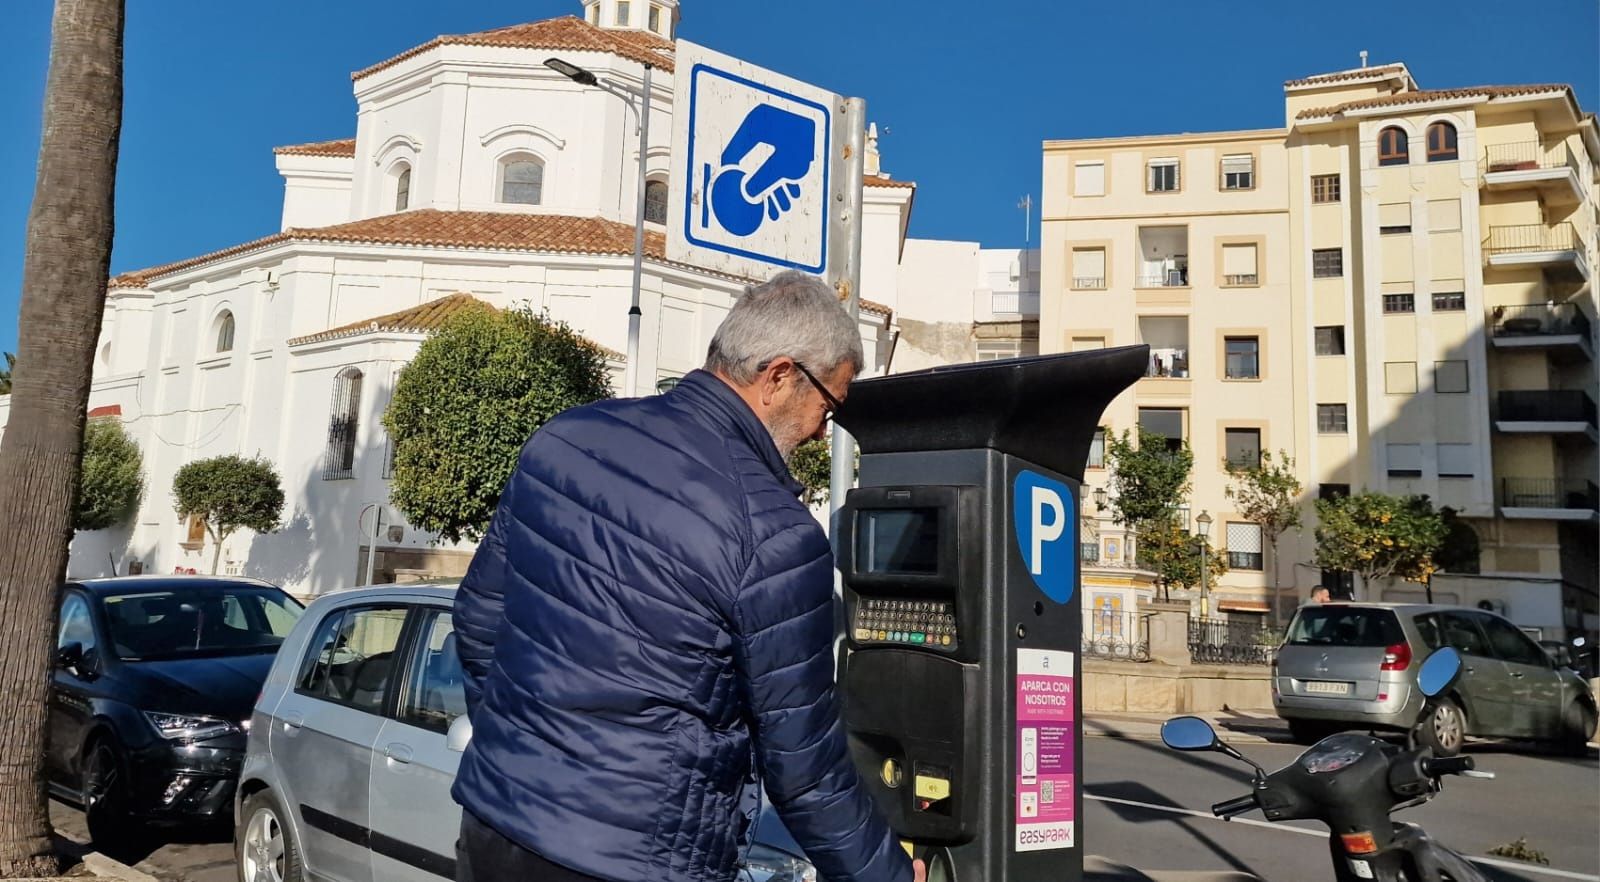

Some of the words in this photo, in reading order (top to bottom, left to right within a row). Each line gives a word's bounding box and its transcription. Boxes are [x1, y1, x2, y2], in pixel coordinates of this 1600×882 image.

[1032, 486, 1065, 575] P
[1021, 681, 1052, 691] APARCA
[1053, 682, 1070, 693] CON
[1025, 694, 1066, 705] NOSOTROS
